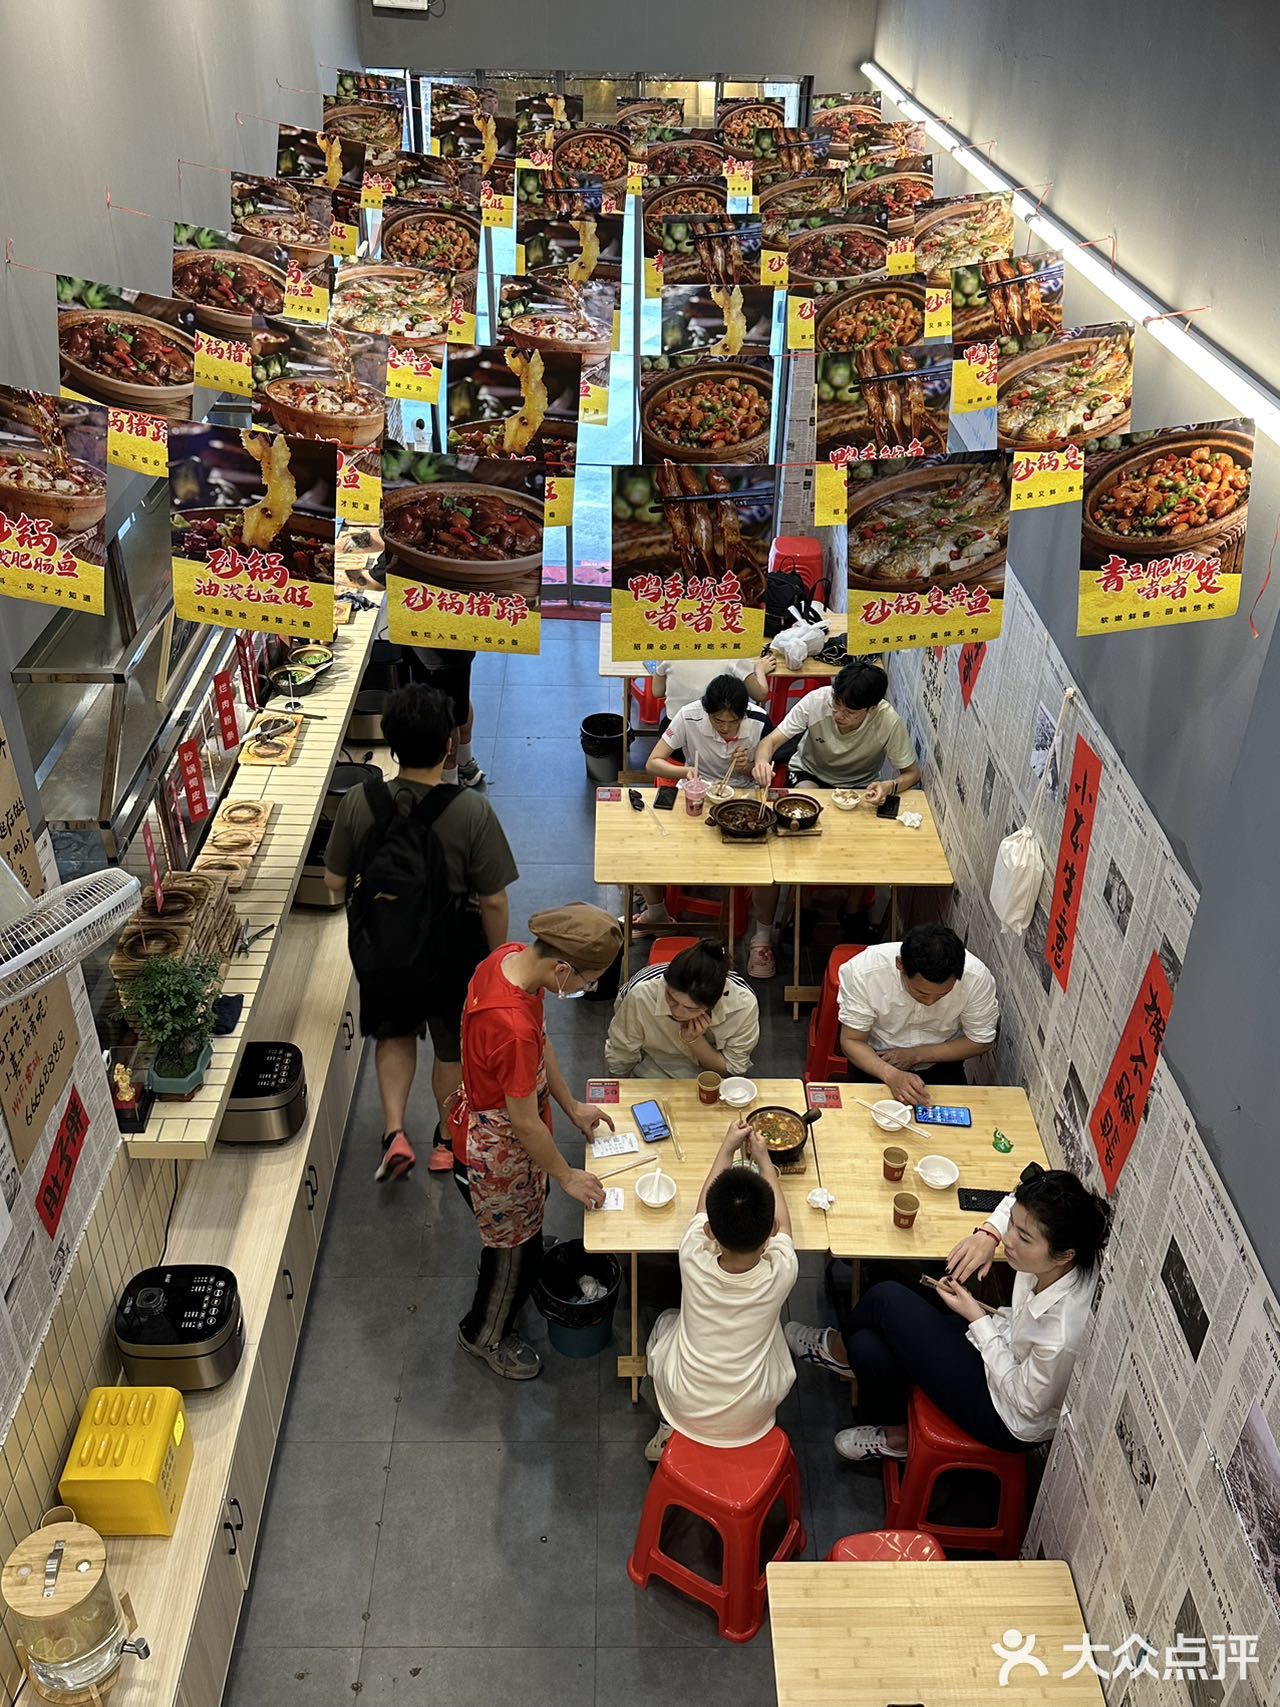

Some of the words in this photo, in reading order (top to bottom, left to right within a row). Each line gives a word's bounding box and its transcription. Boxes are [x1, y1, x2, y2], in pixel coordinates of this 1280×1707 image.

[388, 346, 432, 377] 臭黄鱼
[1013, 446, 1082, 482] 砂锅臭
[205, 547, 288, 588] 砂锅
[193, 578, 313, 610] 油泼毛血旺
[628, 570, 742, 603] 鸭舌鱿鱼
[859, 583, 991, 625] 砂锅臭黄鱼
[401, 584, 530, 627] 砂锅猪蹄
[644, 599, 746, 635] 啫啫煲
[25, 1029, 66, 1128] 66668888
